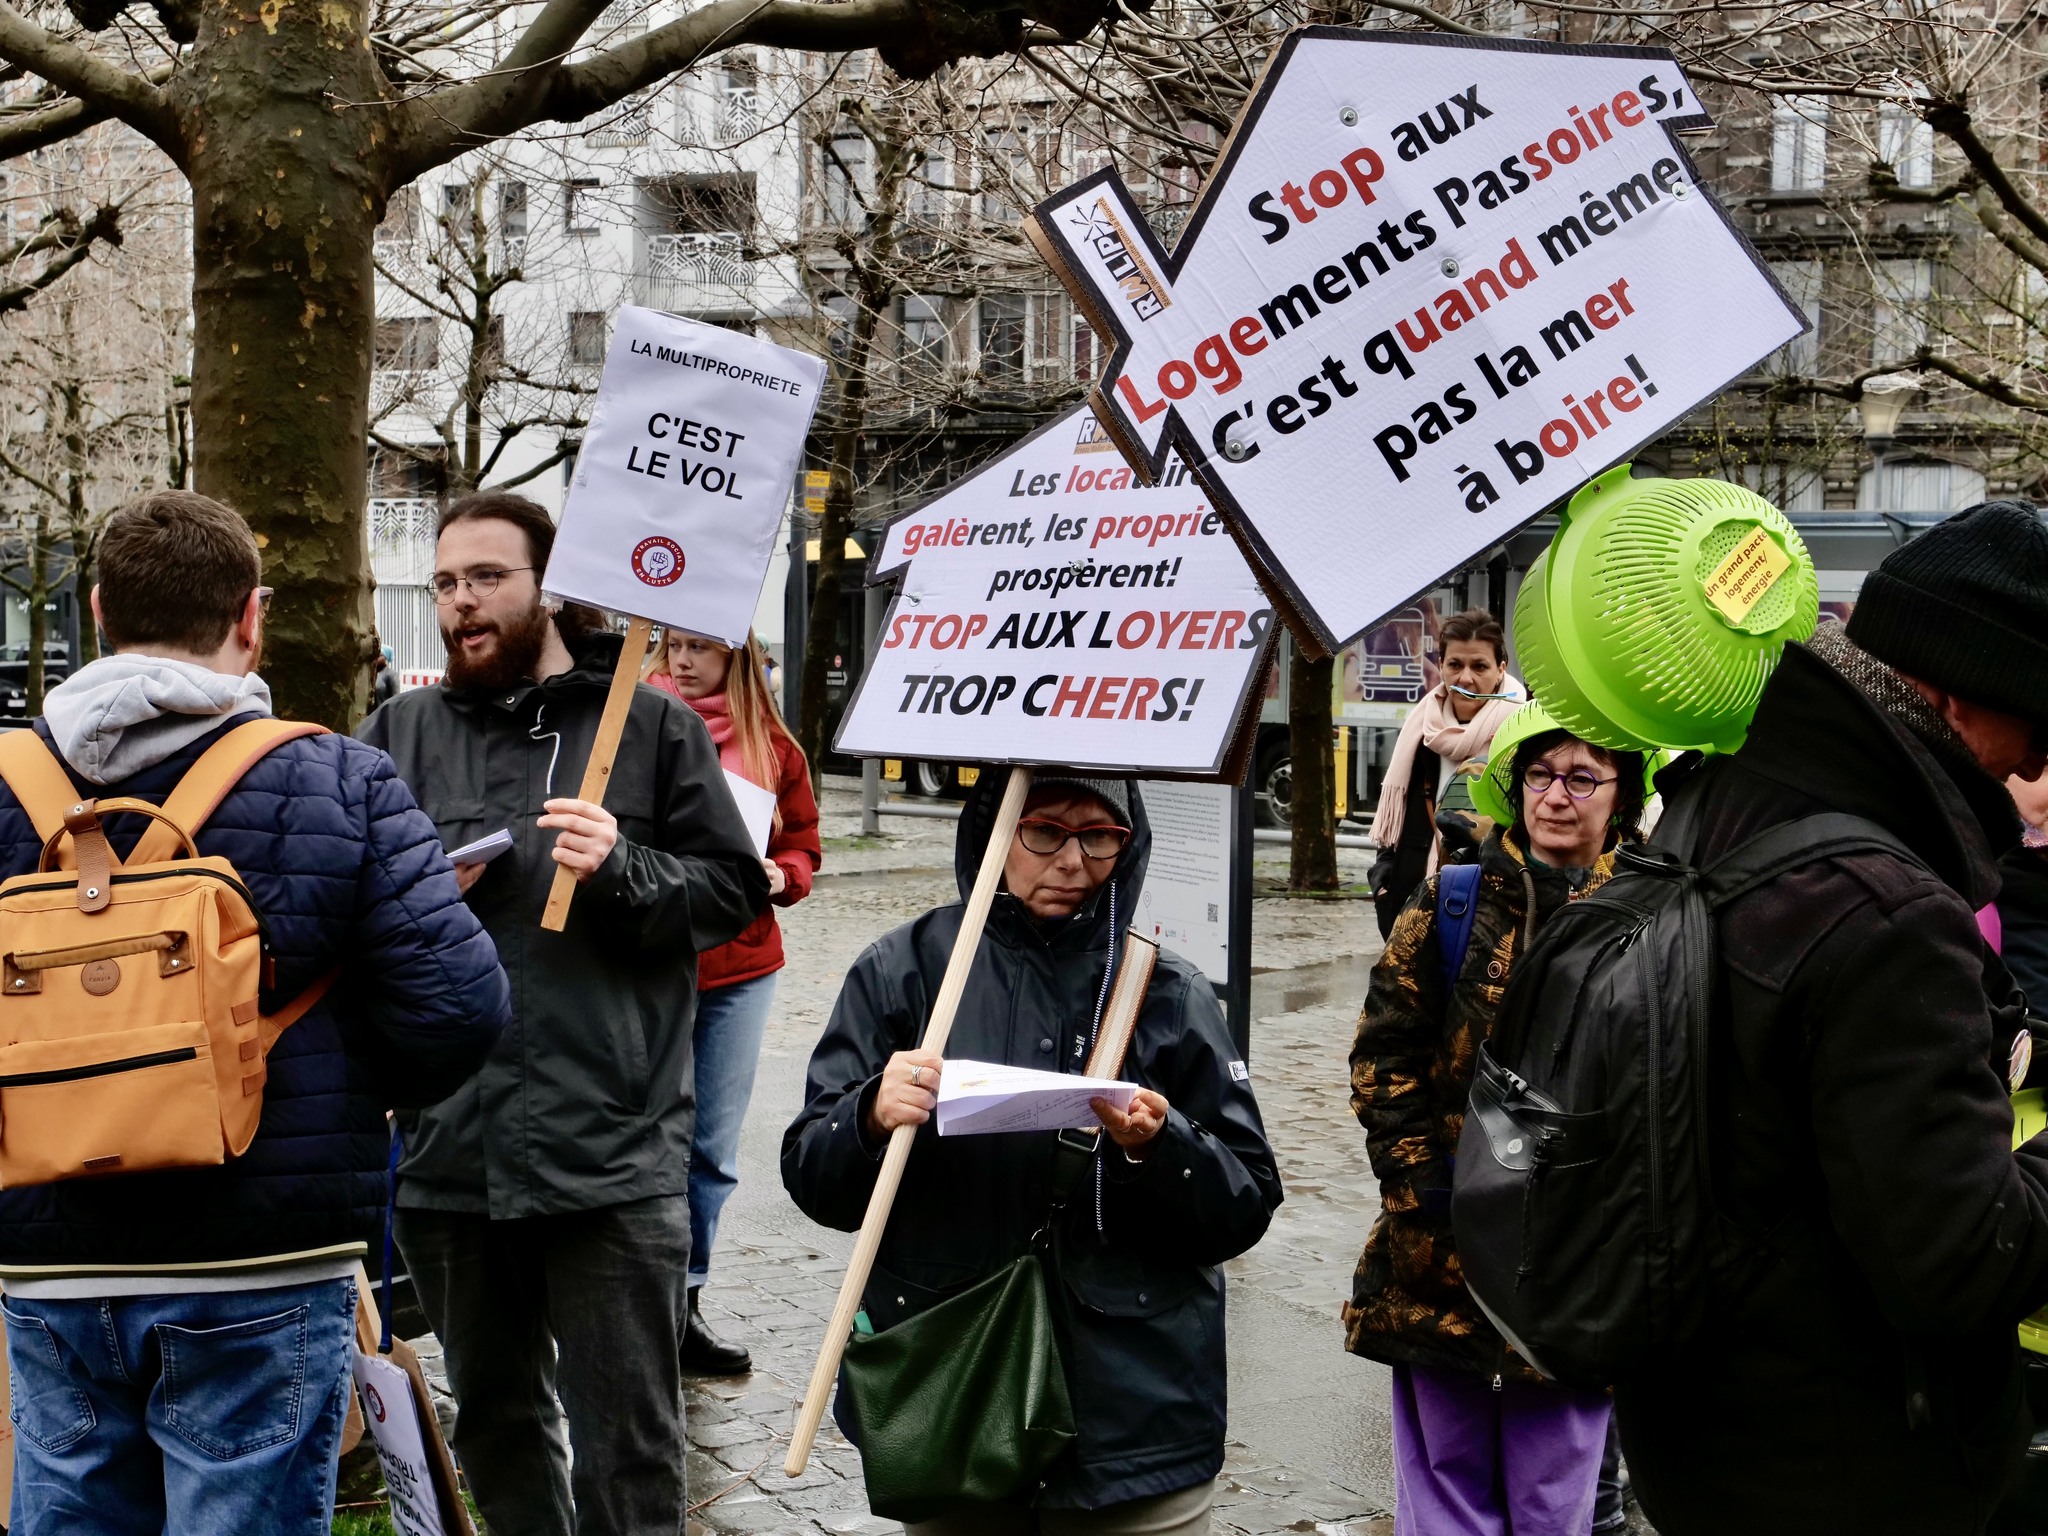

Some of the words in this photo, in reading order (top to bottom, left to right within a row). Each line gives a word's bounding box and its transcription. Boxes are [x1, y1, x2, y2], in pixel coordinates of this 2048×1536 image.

[1248, 148, 1384, 245] Stop
[1391, 84, 1494, 161] aux
[1115, 209, 1436, 424] Logements
[1433, 75, 1683, 229] Passoires,
[1095, 232, 1164, 321] RWLP
[1211, 355, 1359, 463] C'est
[1363, 237, 1538, 380] quand
[1537, 158, 1682, 266] même
[631, 339, 651, 357] LA
[656, 346, 802, 397] MULTIPROPRIETE
[1373, 382, 1477, 483] pas
[1474, 346, 1541, 399] la
[1539, 278, 1634, 361] mer
[647, 413, 745, 458] C'EST
[1454, 464, 1500, 513] à
[1494, 354, 1658, 485] boire!
[627, 446, 671, 479] LE
[681, 458, 742, 500] VOL
[1009, 470, 1060, 497] Les
[637, 539, 664, 552] TRAVAIL
[667, 541, 682, 563] SOCIAL
[903, 515, 1036, 555] galèrent,
[1043, 514, 1089, 541] les
[636, 568, 645, 578] EN
[646, 577, 672, 585] LUTTE
[986, 556, 1182, 601] prospèrent!
[1705, 582, 1720, 598] Un
[1718, 554, 1744, 586] grand
[1743, 530, 1768, 559] pacte
[1724, 550, 1768, 599] logement/
[1741, 569, 1773, 605] énergie
[884, 614, 987, 650] STOP
[986, 611, 1089, 650] AUX
[1088, 609, 1272, 650] LOYERS
[898, 675, 1016, 716] TROP
[1022, 675, 1205, 722] CHERS!
